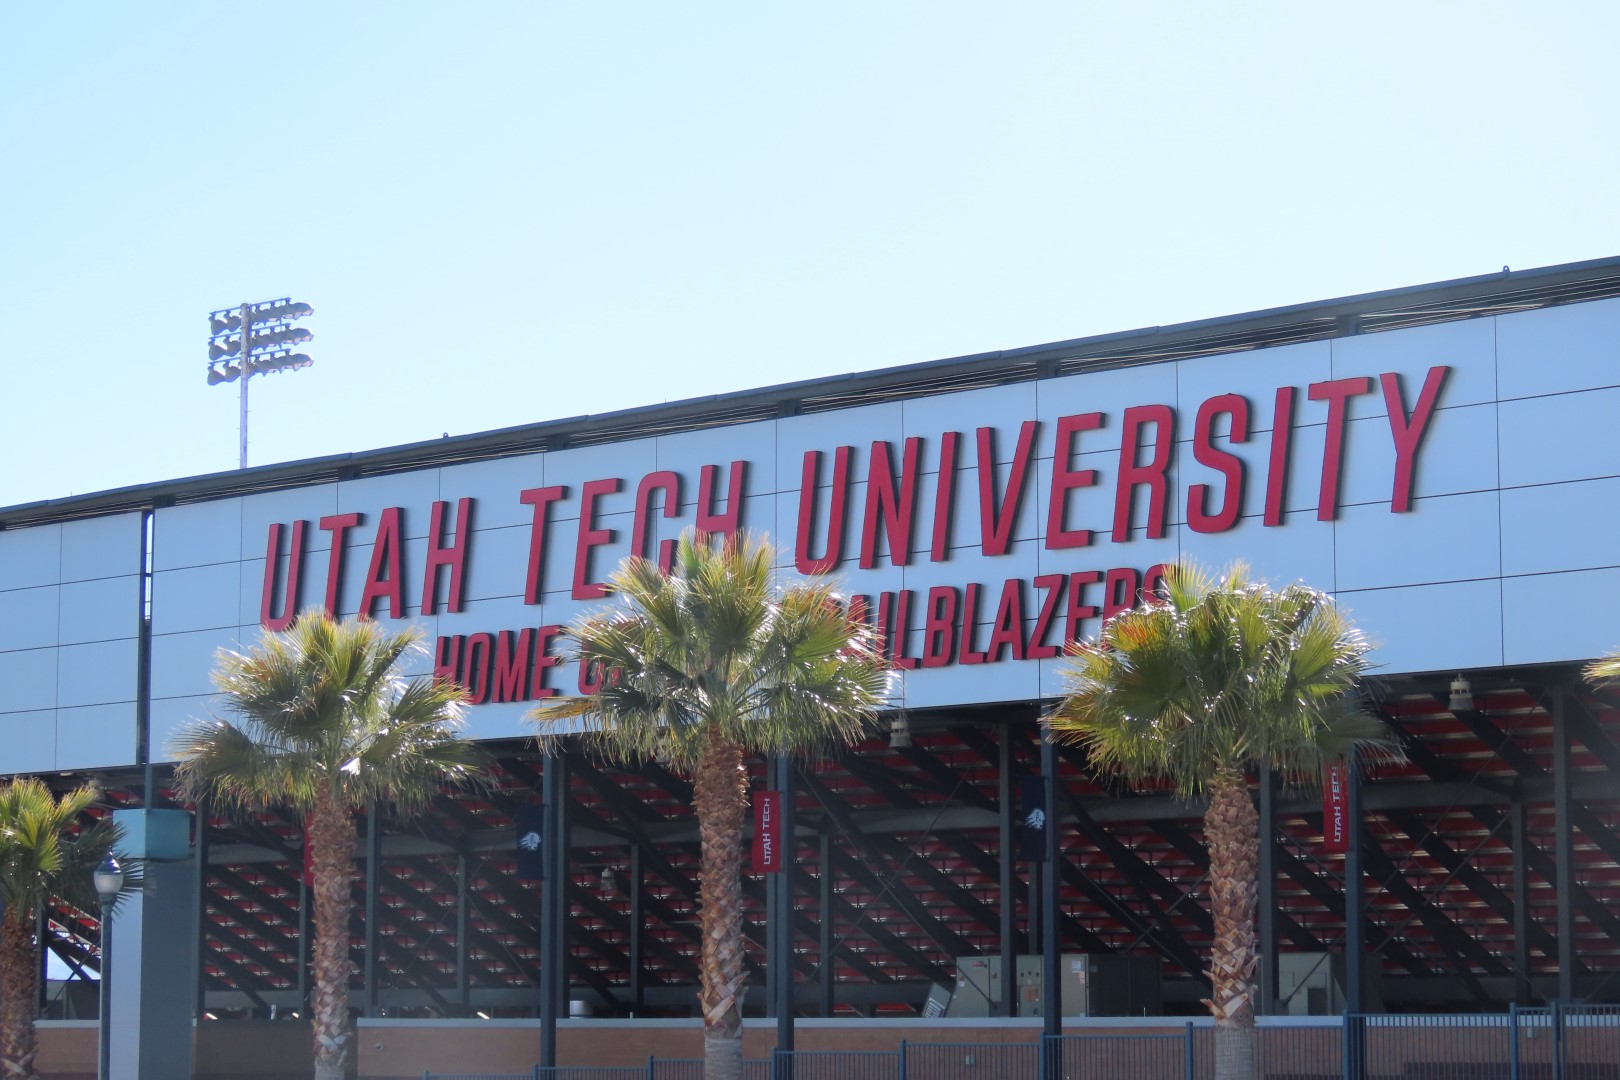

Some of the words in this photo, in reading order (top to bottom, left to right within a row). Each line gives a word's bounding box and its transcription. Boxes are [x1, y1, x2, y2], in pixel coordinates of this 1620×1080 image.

[260, 497, 476, 632] UTAH
[520, 460, 747, 605] TECH
[795, 366, 1451, 575] UNIVERSITY
[432, 624, 565, 705] HOME
[762, 798, 771, 830] TECH
[1333, 806, 1342, 843] UTAH
[762, 833, 772, 865] UTAH
